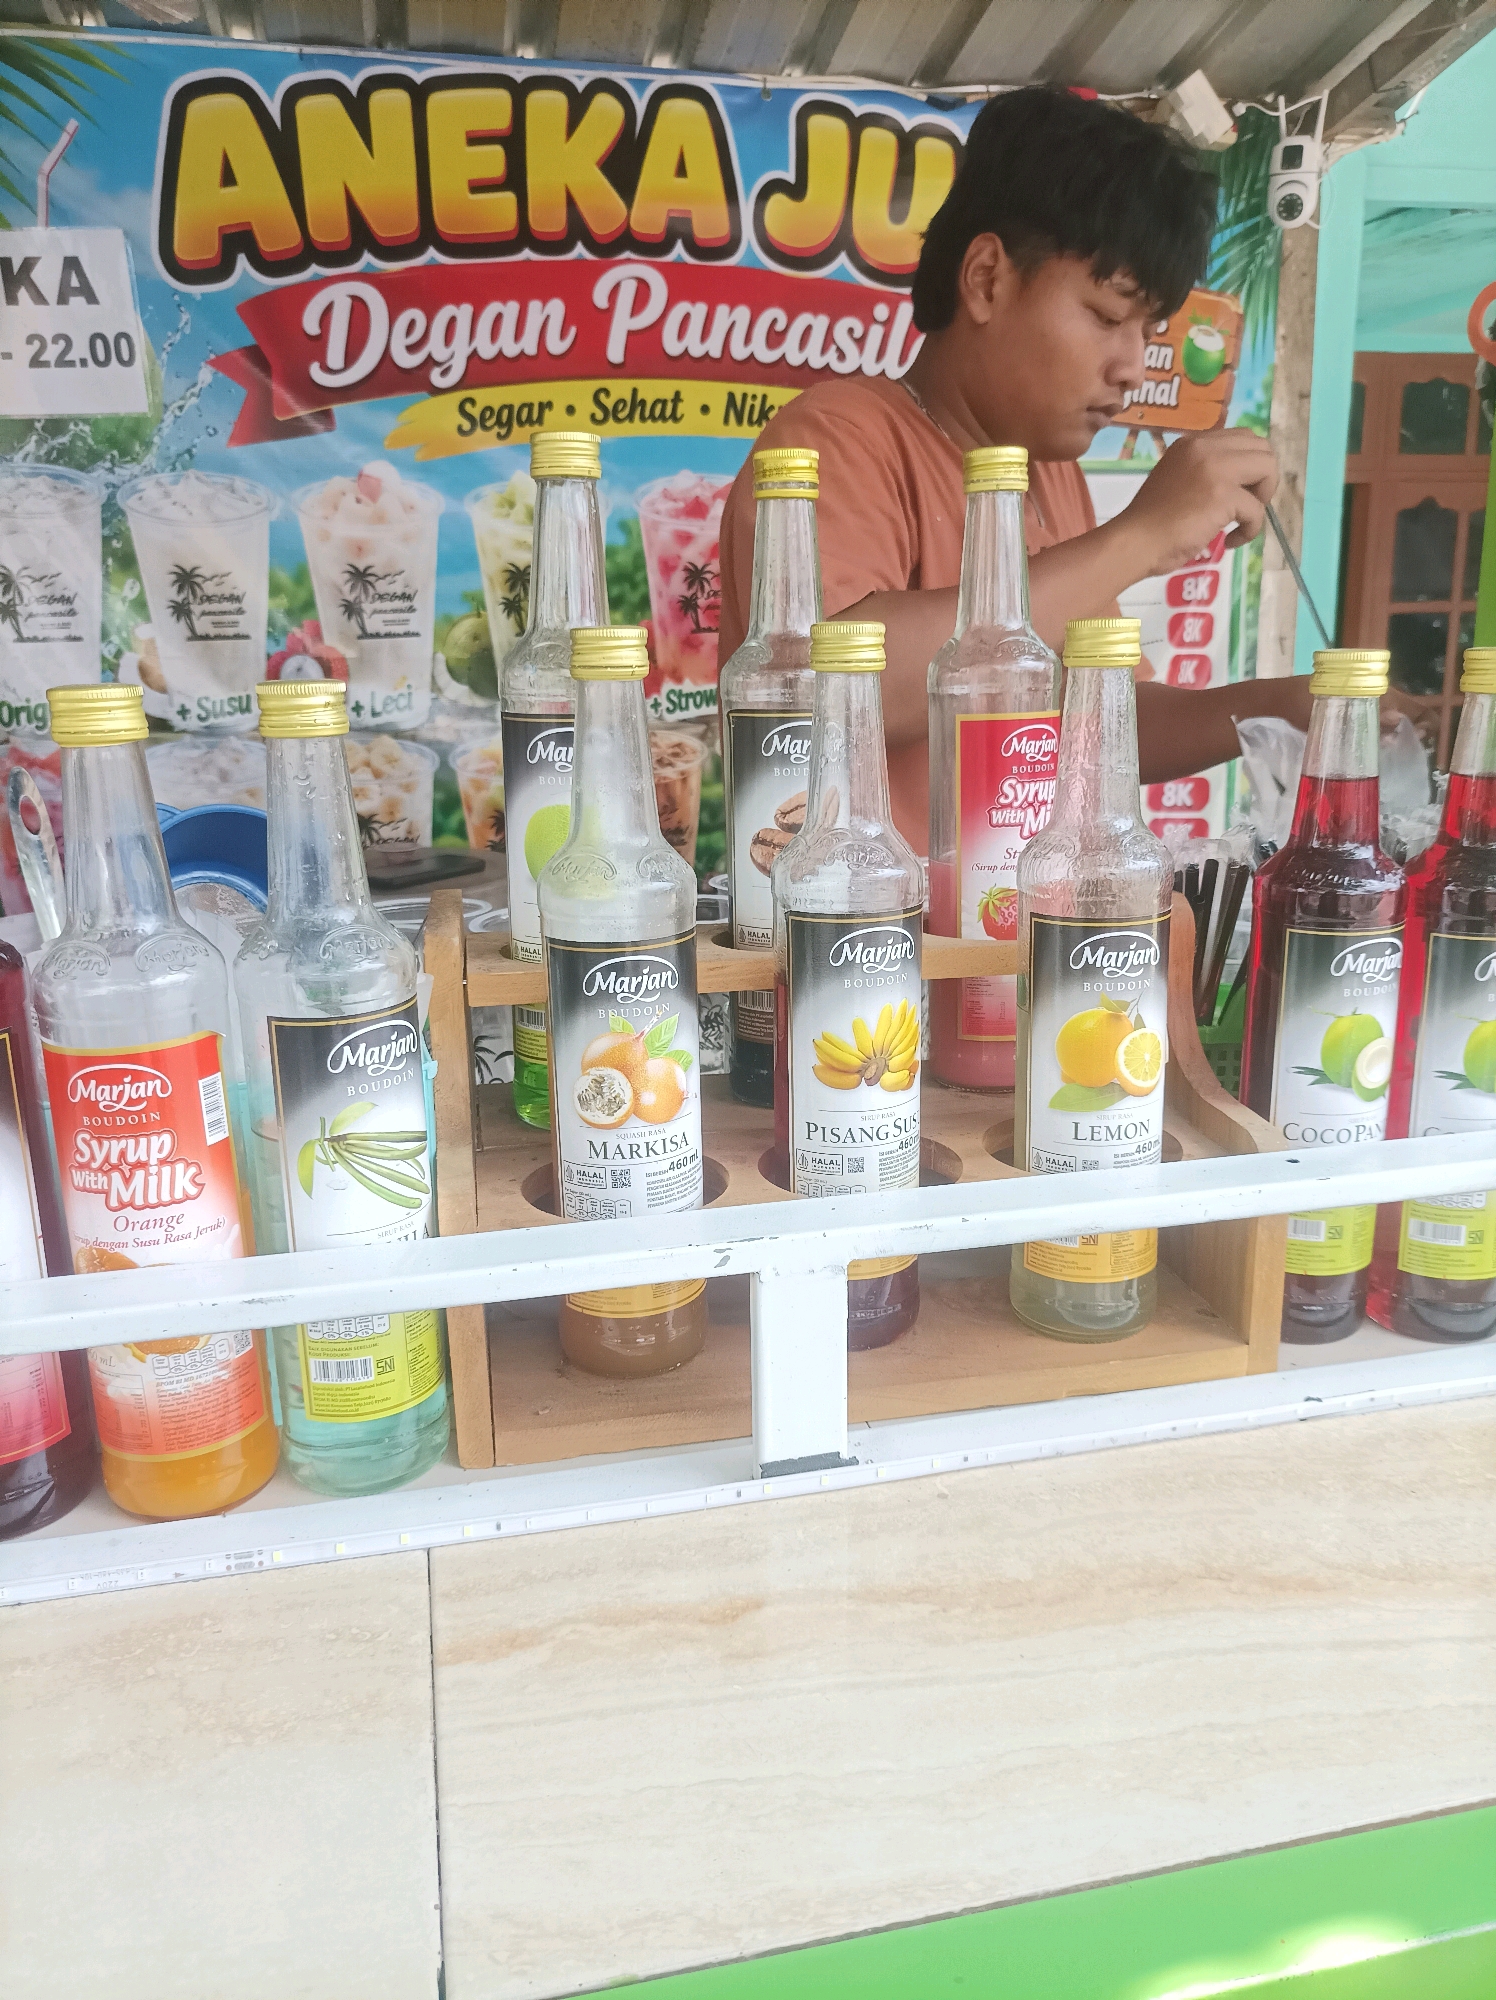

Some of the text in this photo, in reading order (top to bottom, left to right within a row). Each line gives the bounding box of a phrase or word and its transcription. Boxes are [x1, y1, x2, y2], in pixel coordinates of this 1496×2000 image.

[170, 85, 733, 271] ANEKA
[0, 256, 100, 306] KA
[302, 280, 577, 389] Degan
[25, 331, 136, 369] 22.00
[456, 387, 783, 441] Segar Sehat Nik
[1181, 576, 1213, 602] 8K
[1183, 617, 1203, 643] 8K
[0, 697, 48, 731] Orig
[196, 693, 253, 722] Susu
[370, 683, 414, 718] Leci
[1001, 724, 1058, 762] Marjan
[1161, 781, 1195, 808] 8K
[990, 809, 1024, 826] With
[971, 862, 998, 873] (Sirup
[747, 930, 771, 940] HALAL
[520, 946, 542, 956] HALAL
[829, 926, 915, 974] Marjan
[1069, 931, 1160, 978] Marjan
[582, 954, 679, 1005] Marjan
[843, 973, 909, 989] BOUDOIN
[1083, 979, 1151, 992] BOUDOIN
[598, 1003, 671, 1019] BOUDOIN
[326, 1019, 418, 1077] Marjan
[67, 1063, 173, 1113] Marjan
[346, 1068, 415, 1097] BOUDOIN
[83, 1111, 162, 1127] BOUDOIN
[1071, 1118, 1151, 1142] LEMON
[74, 1132, 173, 1168] Syrup
[586, 1131, 690, 1160] MARKISA
[898, 1136, 913, 1151] 460
[1134, 1140, 1153, 1155] 460
[576, 1169, 604, 1180] HALAL
[668, 1155, 688, 1172] 460
[811, 1156, 841, 1167] HALAL
[1045, 1156, 1074, 1168] HALAL
[71, 1162, 200, 1208] With Milk
[92, 1234, 129, 1251] dengan
[132, 1236, 160, 1249] Susu
[163, 1231, 192, 1245] Rasa
[193, 1216, 226, 1240] Jeruk)
[113, 1212, 185, 1233] Orange
